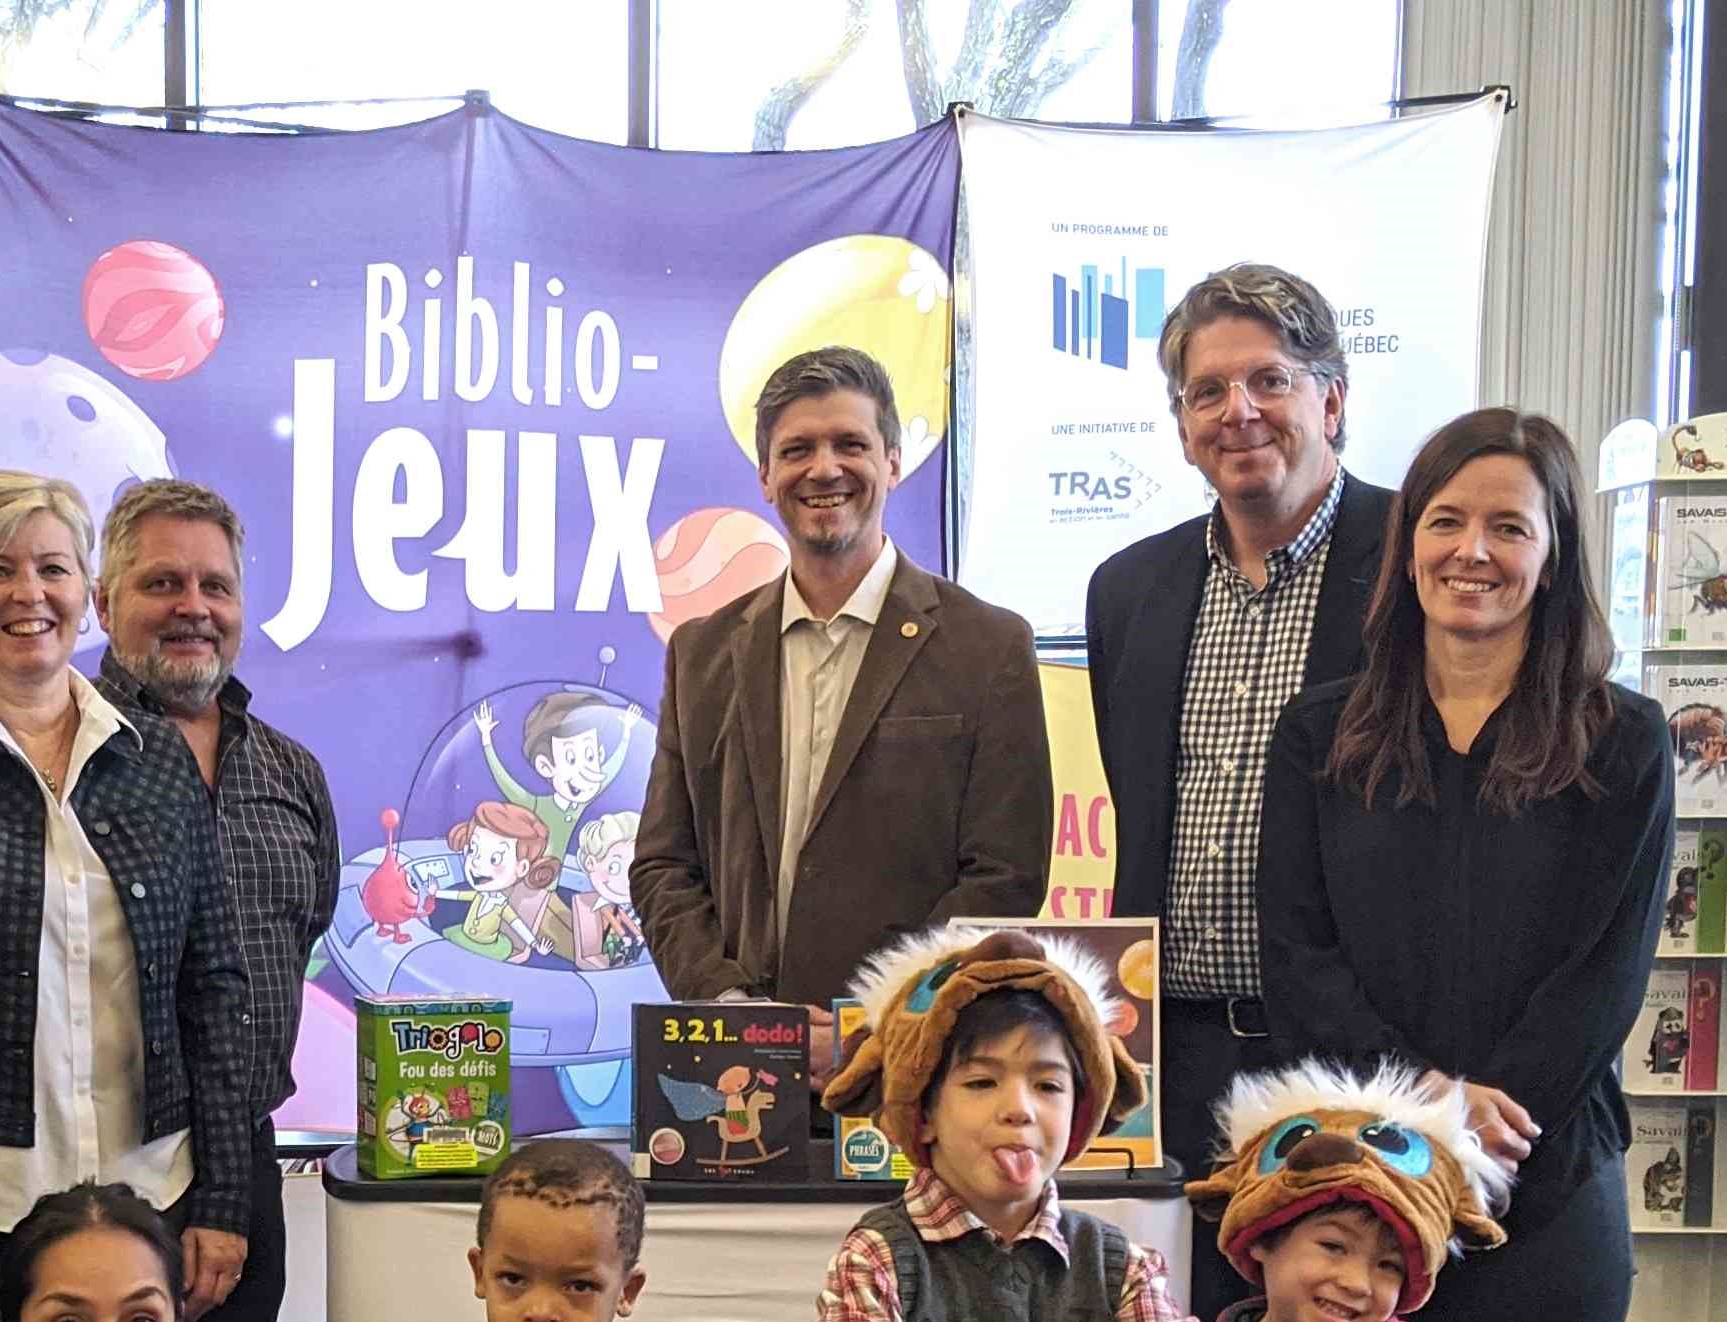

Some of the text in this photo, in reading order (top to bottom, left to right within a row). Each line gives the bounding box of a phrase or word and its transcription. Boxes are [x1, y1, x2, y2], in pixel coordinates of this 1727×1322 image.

[1051, 222, 1170, 237] UN PROGRAMME DE
[364, 255, 658, 410] Biblio-
[1345, 332, 1400, 354] UÉBEC
[1051, 421, 1156, 435] UNE INITIATIVE DE
[1048, 471, 1132, 501] TRAS
[259, 357, 666, 652] Jeux
[1668, 676, 1727, 688] SAVAIS-
[390, 1019, 505, 1061] Triogolo
[742, 1023, 804, 1045] dodo!
[399, 1059, 498, 1079] Fou des défis
